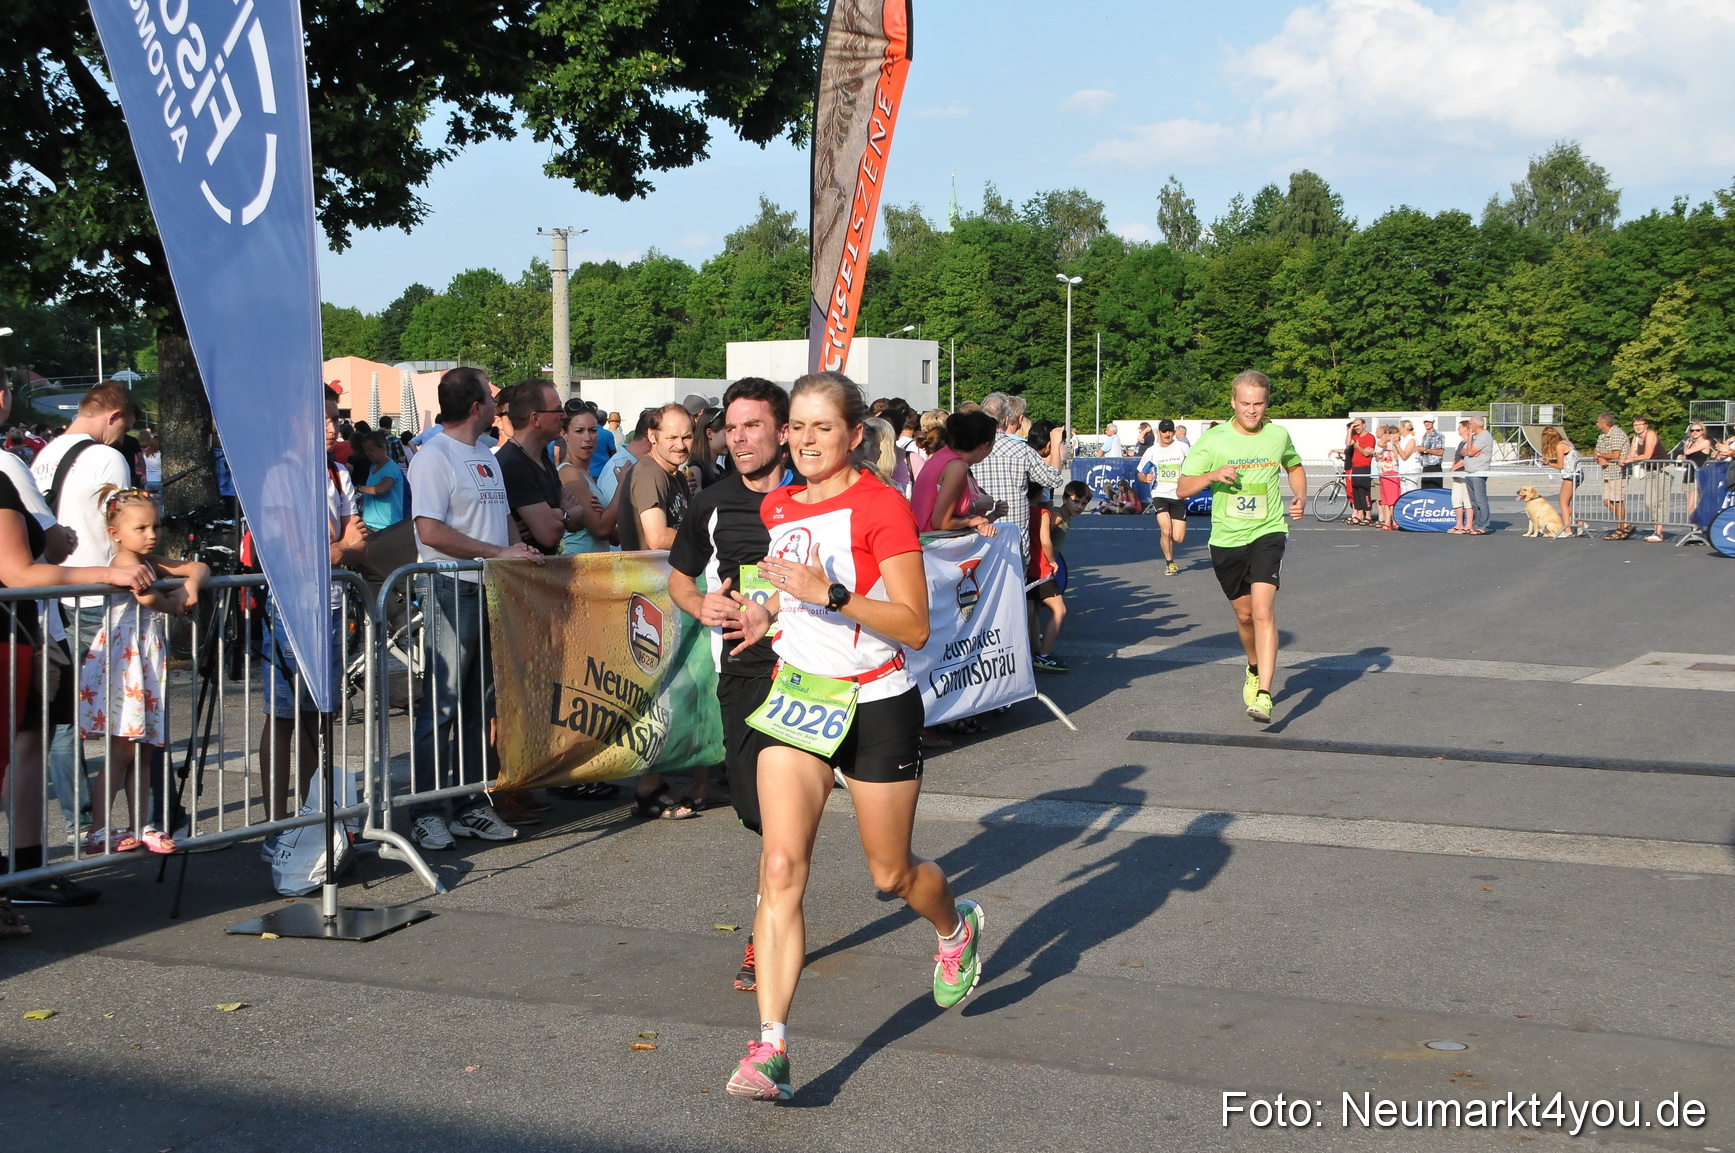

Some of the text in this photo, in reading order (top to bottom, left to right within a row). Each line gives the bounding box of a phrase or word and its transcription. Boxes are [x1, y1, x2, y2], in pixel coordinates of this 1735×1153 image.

[1161, 469, 1176, 479] 209
[1236, 496, 1257, 512] 34
[1413, 506, 1456, 518] Fische
[639, 650, 655, 668] 1628
[928, 647, 1016, 699] Lammsbräu
[766, 695, 847, 739] 1026
